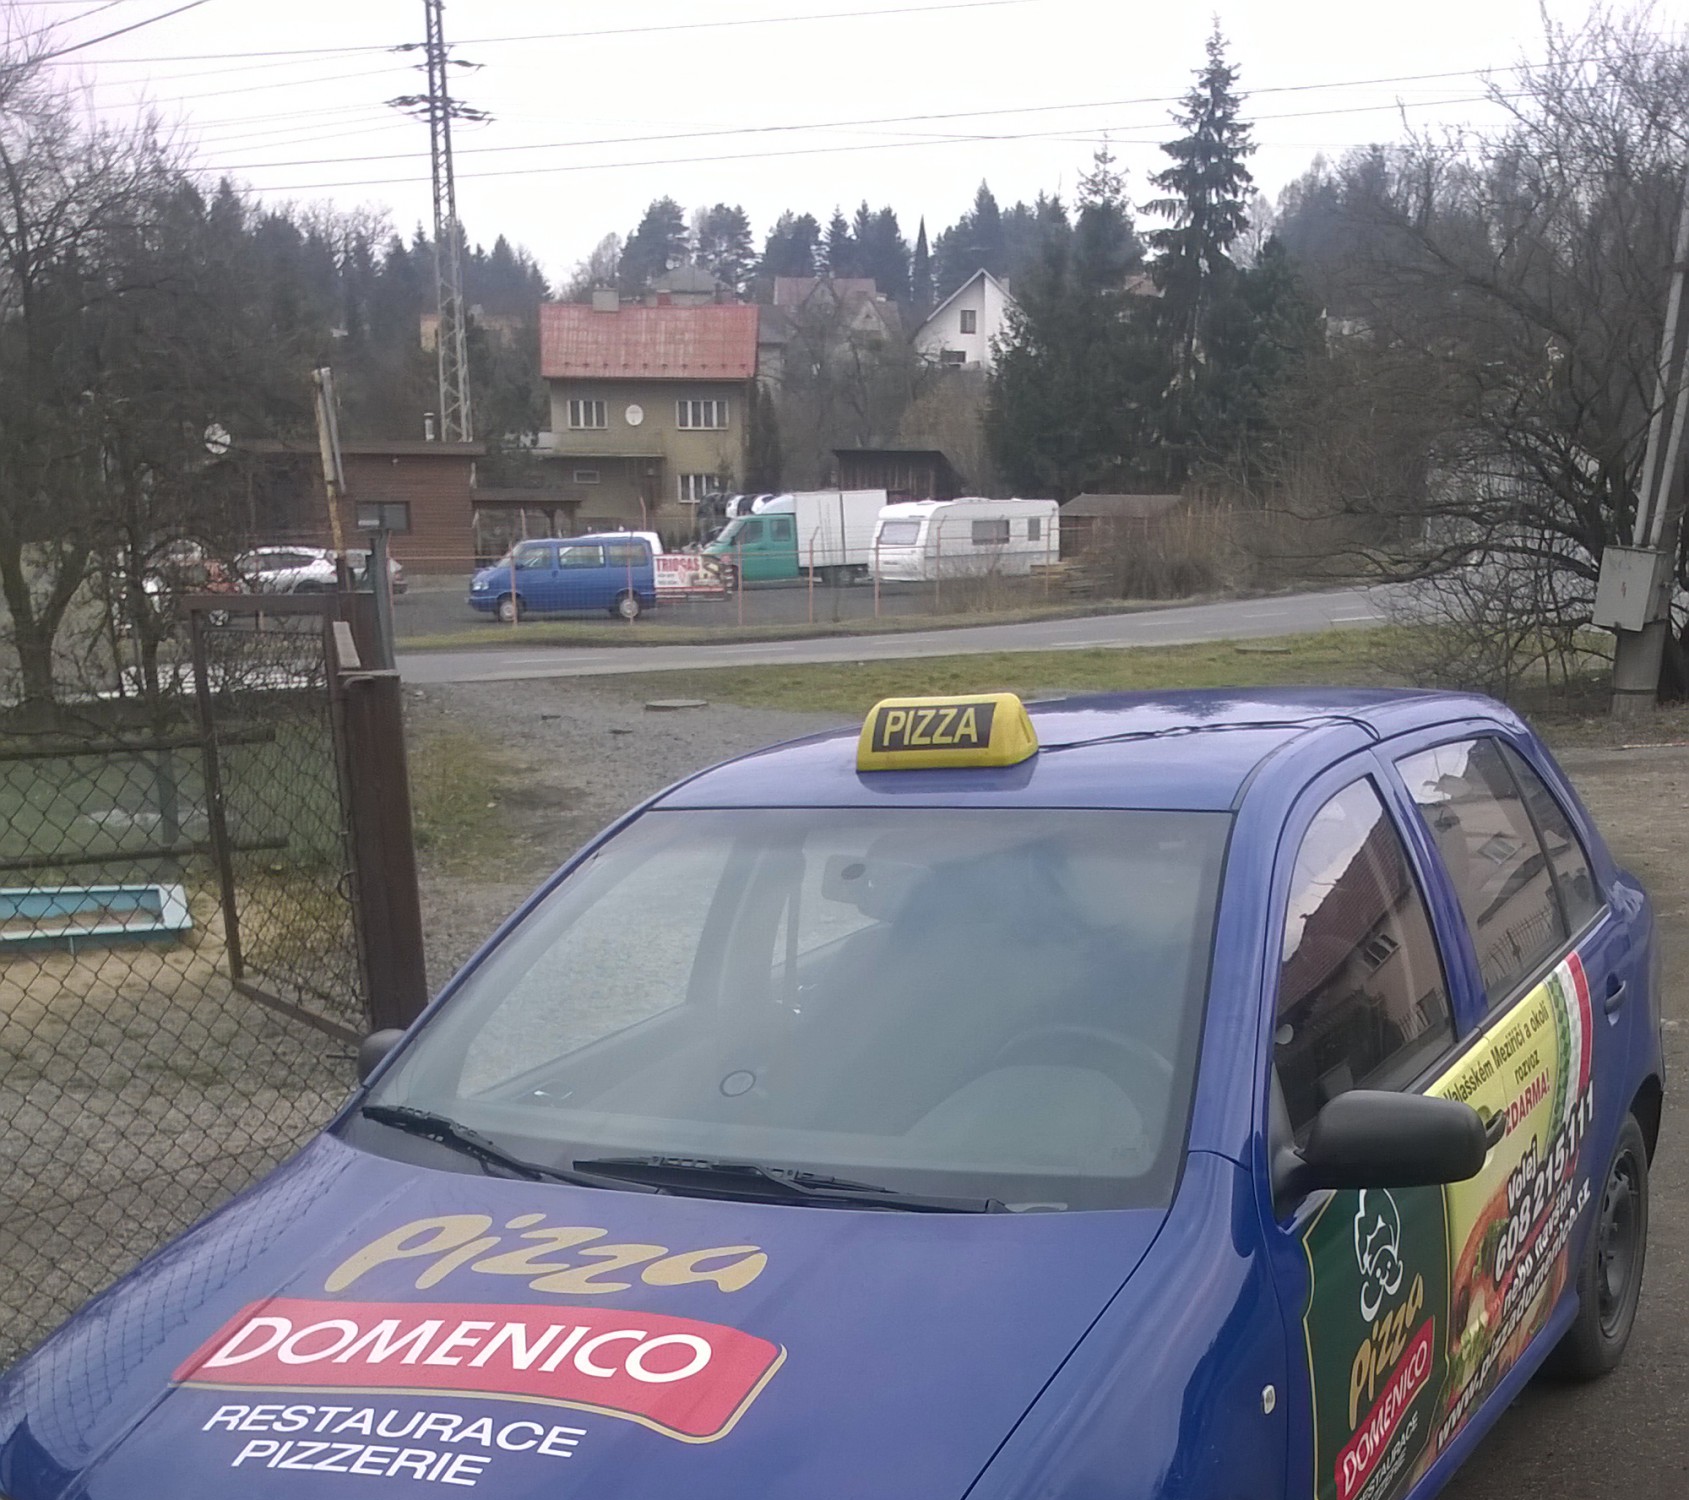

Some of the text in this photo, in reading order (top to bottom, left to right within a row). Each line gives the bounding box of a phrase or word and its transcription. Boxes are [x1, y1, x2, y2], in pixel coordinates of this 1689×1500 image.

[882, 707, 978, 747] PIZZA
[1490, 1023, 1526, 1070] Meziříčí
[1523, 1021, 1532, 1038] a
[1514, 1049, 1540, 1085] rozvoz
[1504, 1067, 1550, 1138] ZDARMA!
[1495, 1079, 1594, 1282] 608 215 111
[1508, 1139, 1537, 1210] Volej
[1503, 1257, 1534, 1316] nebo
[203, 1316, 713, 1384] DOMENICO
[202, 1404, 588, 1459] RESTAURACE
[1343, 1340, 1428, 1497] DOMENICO
[231, 1440, 492, 1487] PIZZERIE
